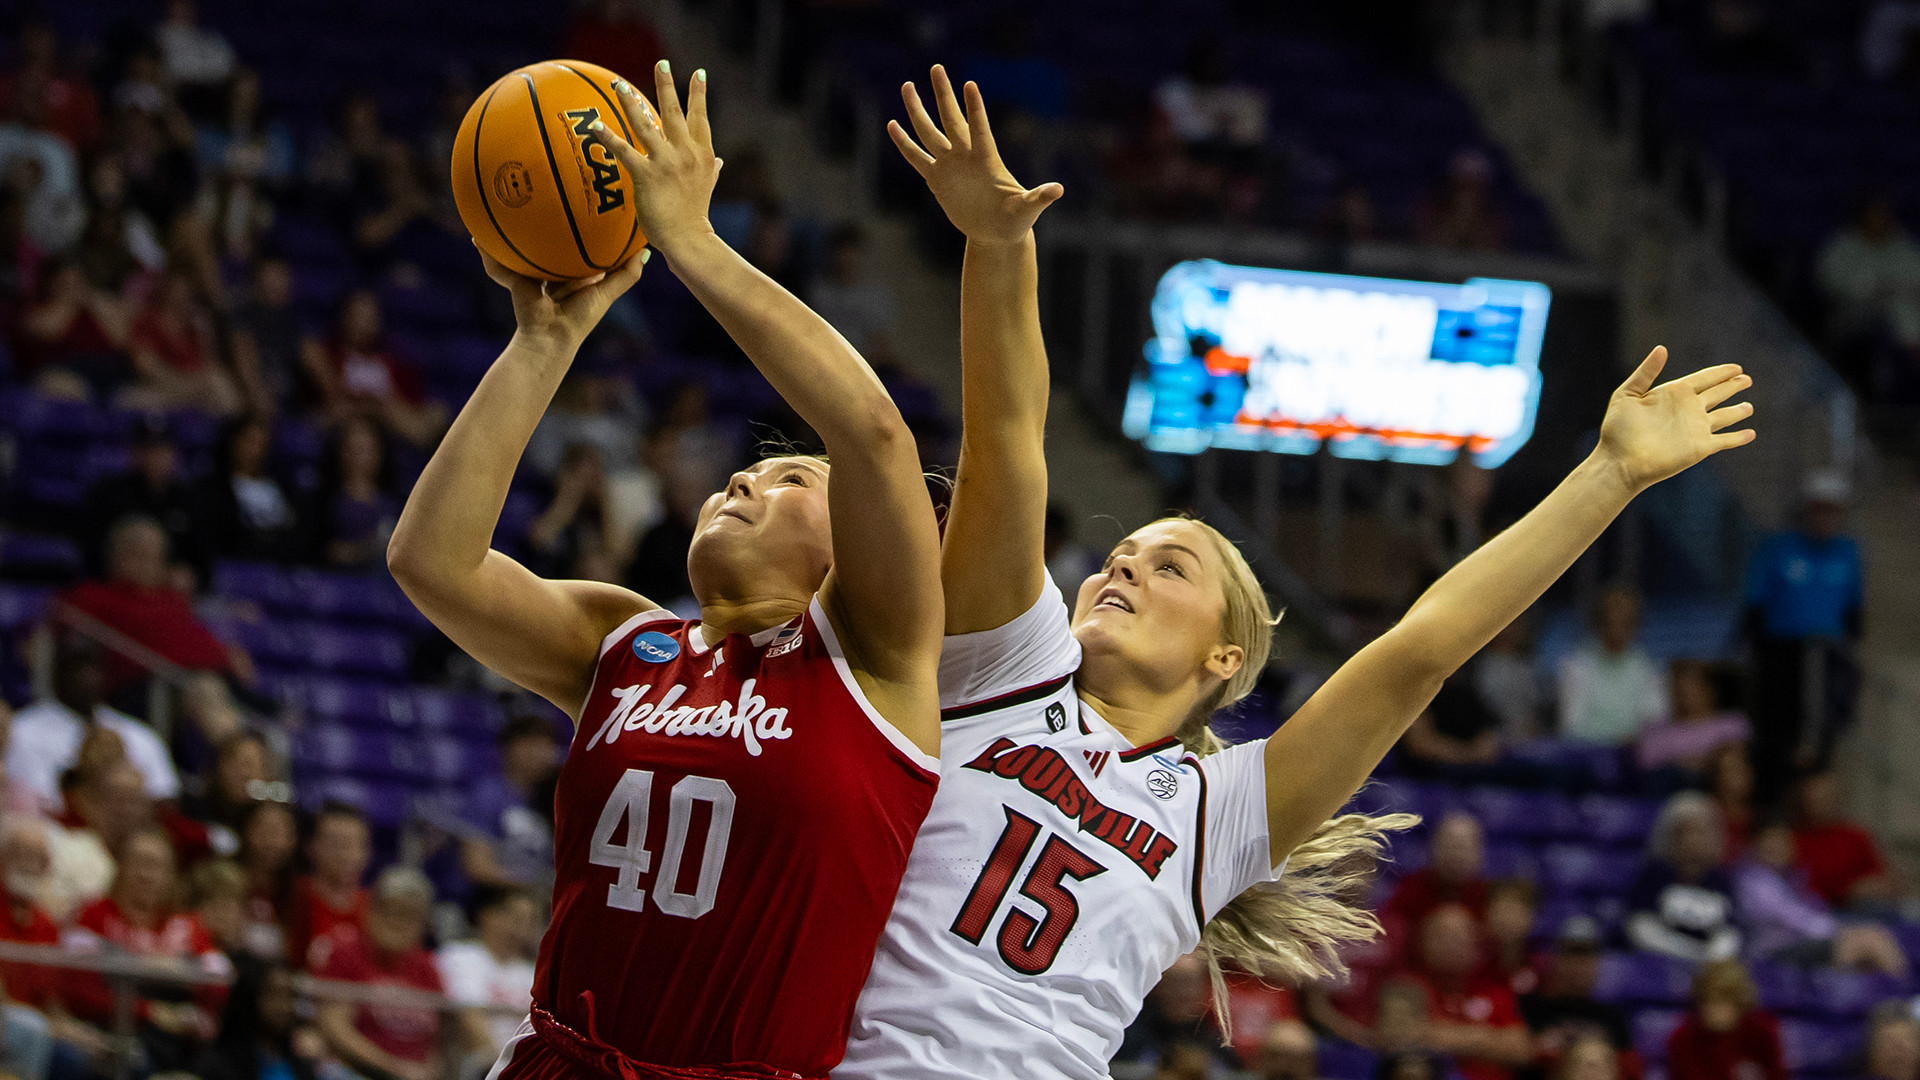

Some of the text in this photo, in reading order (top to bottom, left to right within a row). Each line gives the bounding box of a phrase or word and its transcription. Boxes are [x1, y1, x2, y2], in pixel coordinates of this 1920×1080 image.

[563, 106, 626, 215] NCAA
[636, 640, 673, 660] NCAA
[586, 678, 793, 757] Nebraska
[1048, 708, 1064, 731] JB
[960, 737, 1178, 881] LOUISVILLE
[1149, 777, 1178, 792] ACC
[589, 768, 737, 919] 40
[949, 803, 1109, 976] 15
